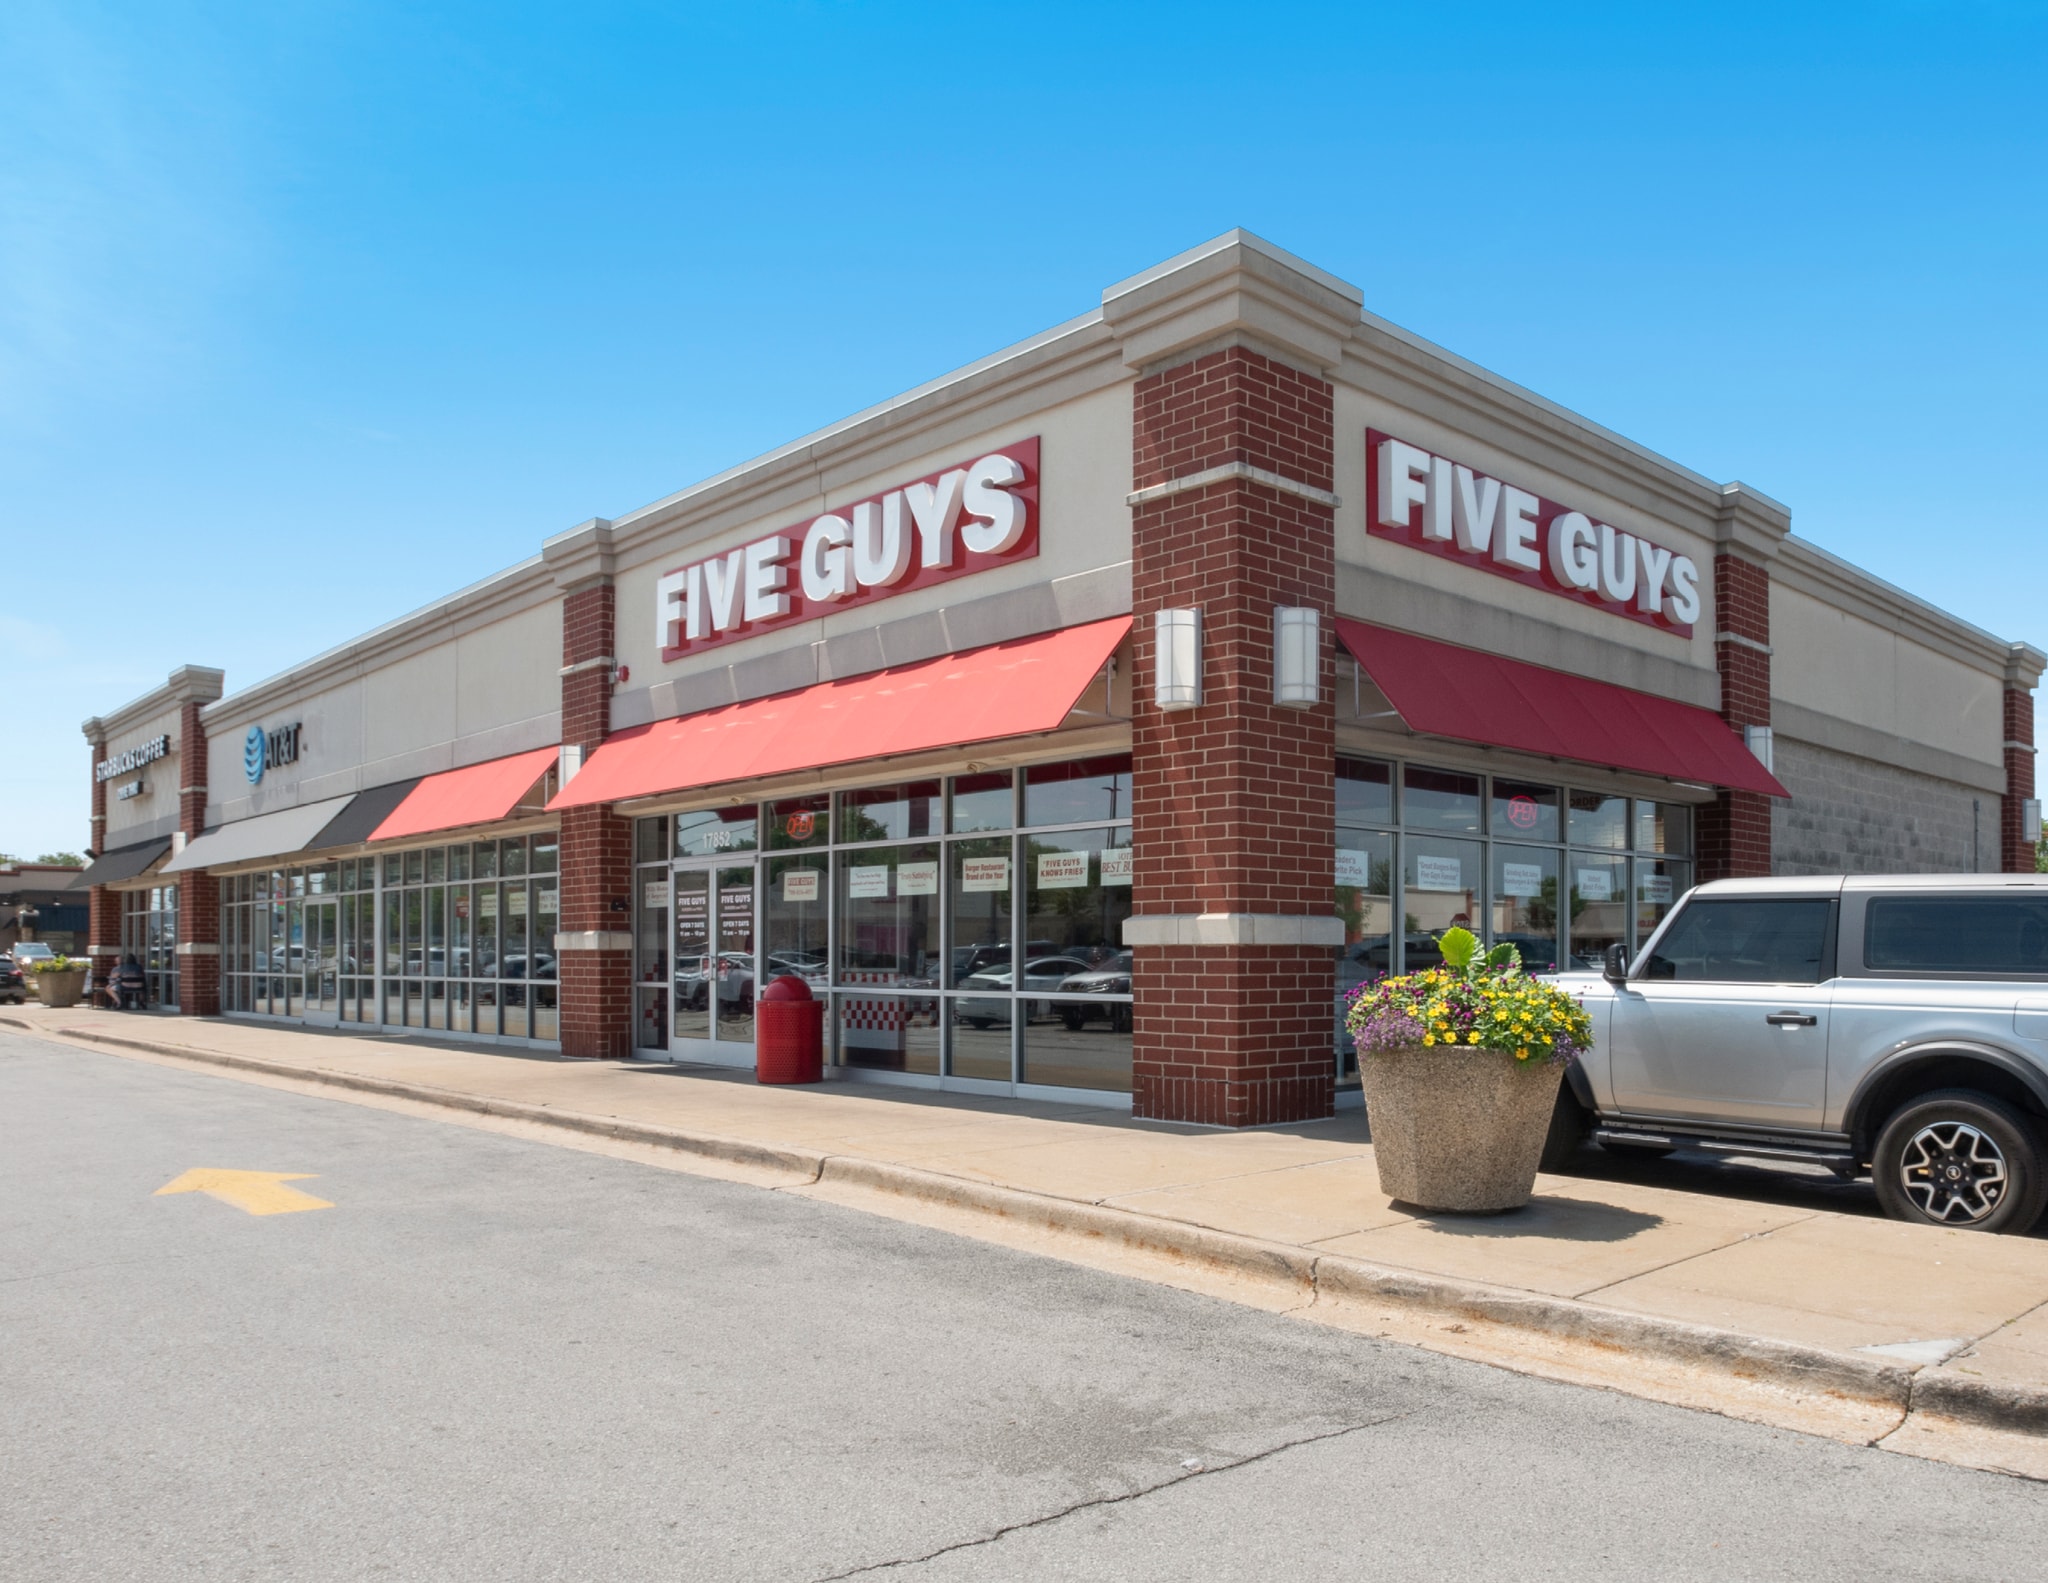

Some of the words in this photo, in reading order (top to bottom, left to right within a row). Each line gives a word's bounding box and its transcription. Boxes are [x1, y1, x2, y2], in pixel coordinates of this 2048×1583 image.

[1378, 438, 1541, 572] FIVE
[1548, 511, 1700, 625] GUYS
[656, 535, 791, 648] FIVE
[801, 453, 1026, 601] GUYS
[265, 722, 301, 770] AT&T
[96, 749, 136, 783] STARBUCKS
[135, 734, 168, 768] COFFEE
[1508, 802, 1537, 821] OPEN
[787, 813, 814, 836] OPEN
[703, 831, 731, 848] 17852
[965, 864, 980, 872] Burger
[981, 863, 1005, 871] Restaurant
[1062, 858, 1081, 867] GUYS
[1102, 861, 1121, 873] BEST
[1040, 869, 1063, 877] KNOWS
[1348, 866, 1362, 875] Pick
[678, 897, 691, 906] FIVE
[691, 896, 706, 905] GUYS
[721, 895, 734, 904] FIVE
[734, 894, 752, 903] GUYS
[722, 920, 734, 928] OPEN
